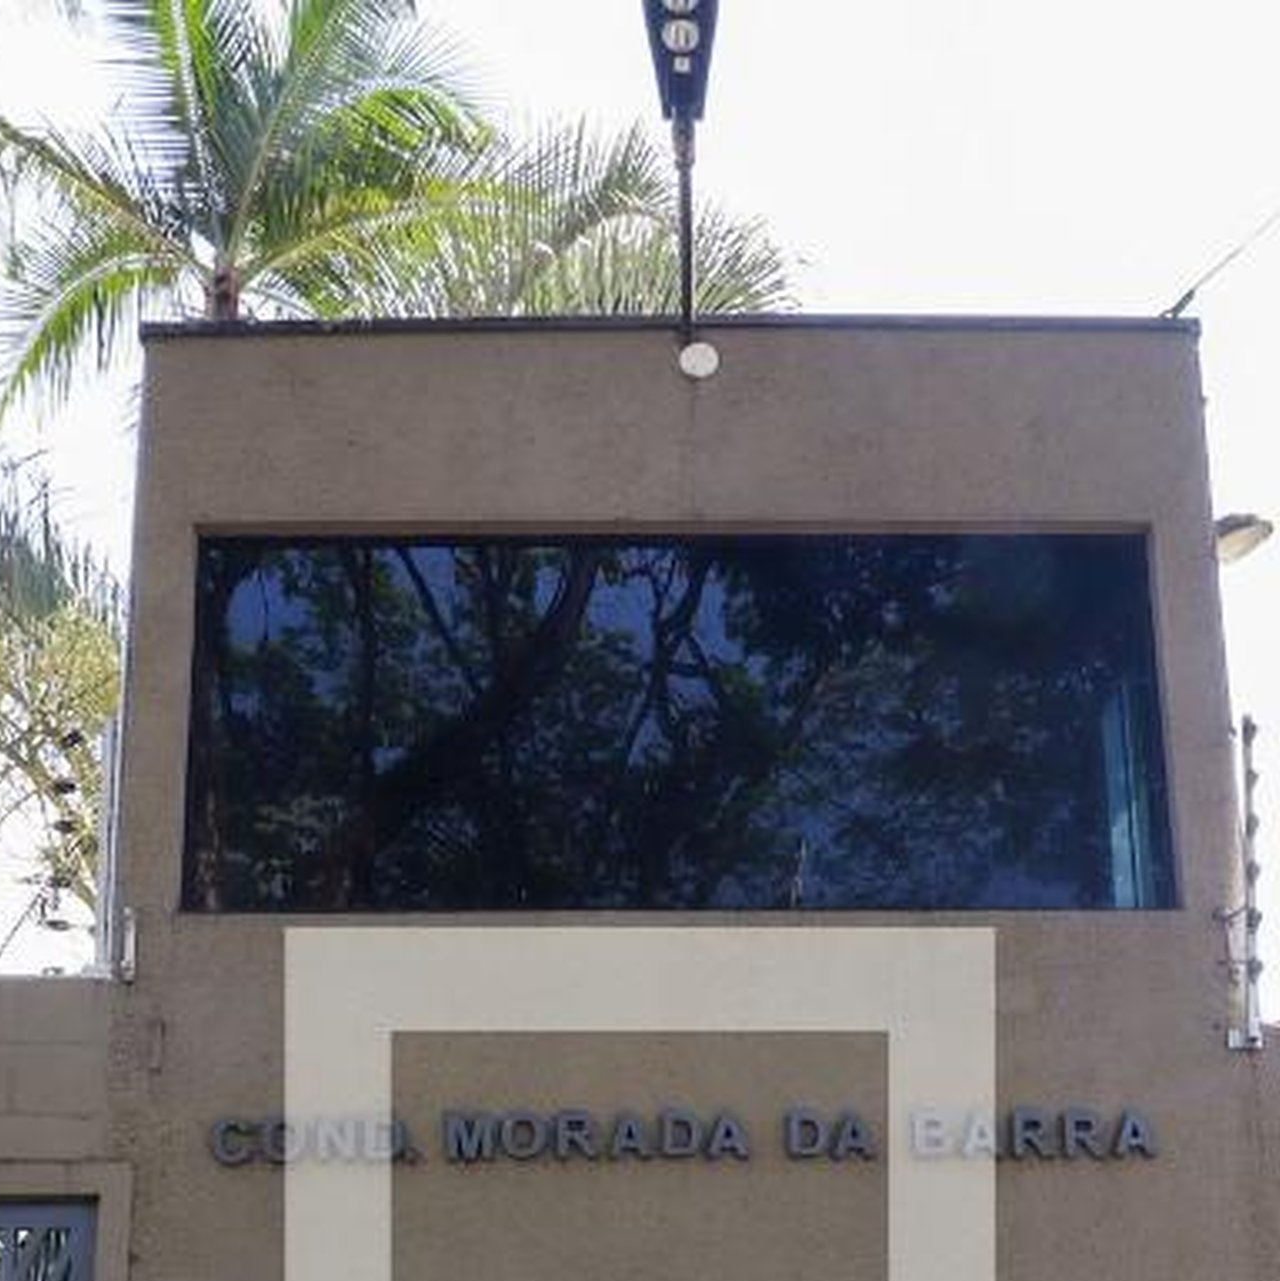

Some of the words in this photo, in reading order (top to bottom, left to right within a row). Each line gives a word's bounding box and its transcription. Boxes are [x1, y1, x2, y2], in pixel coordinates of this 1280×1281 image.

[213, 1119, 426, 1166] COND.
[442, 1110, 749, 1162] MORADA
[784, 1106, 877, 1160] DA
[910, 1106, 1158, 1160] BARRA
